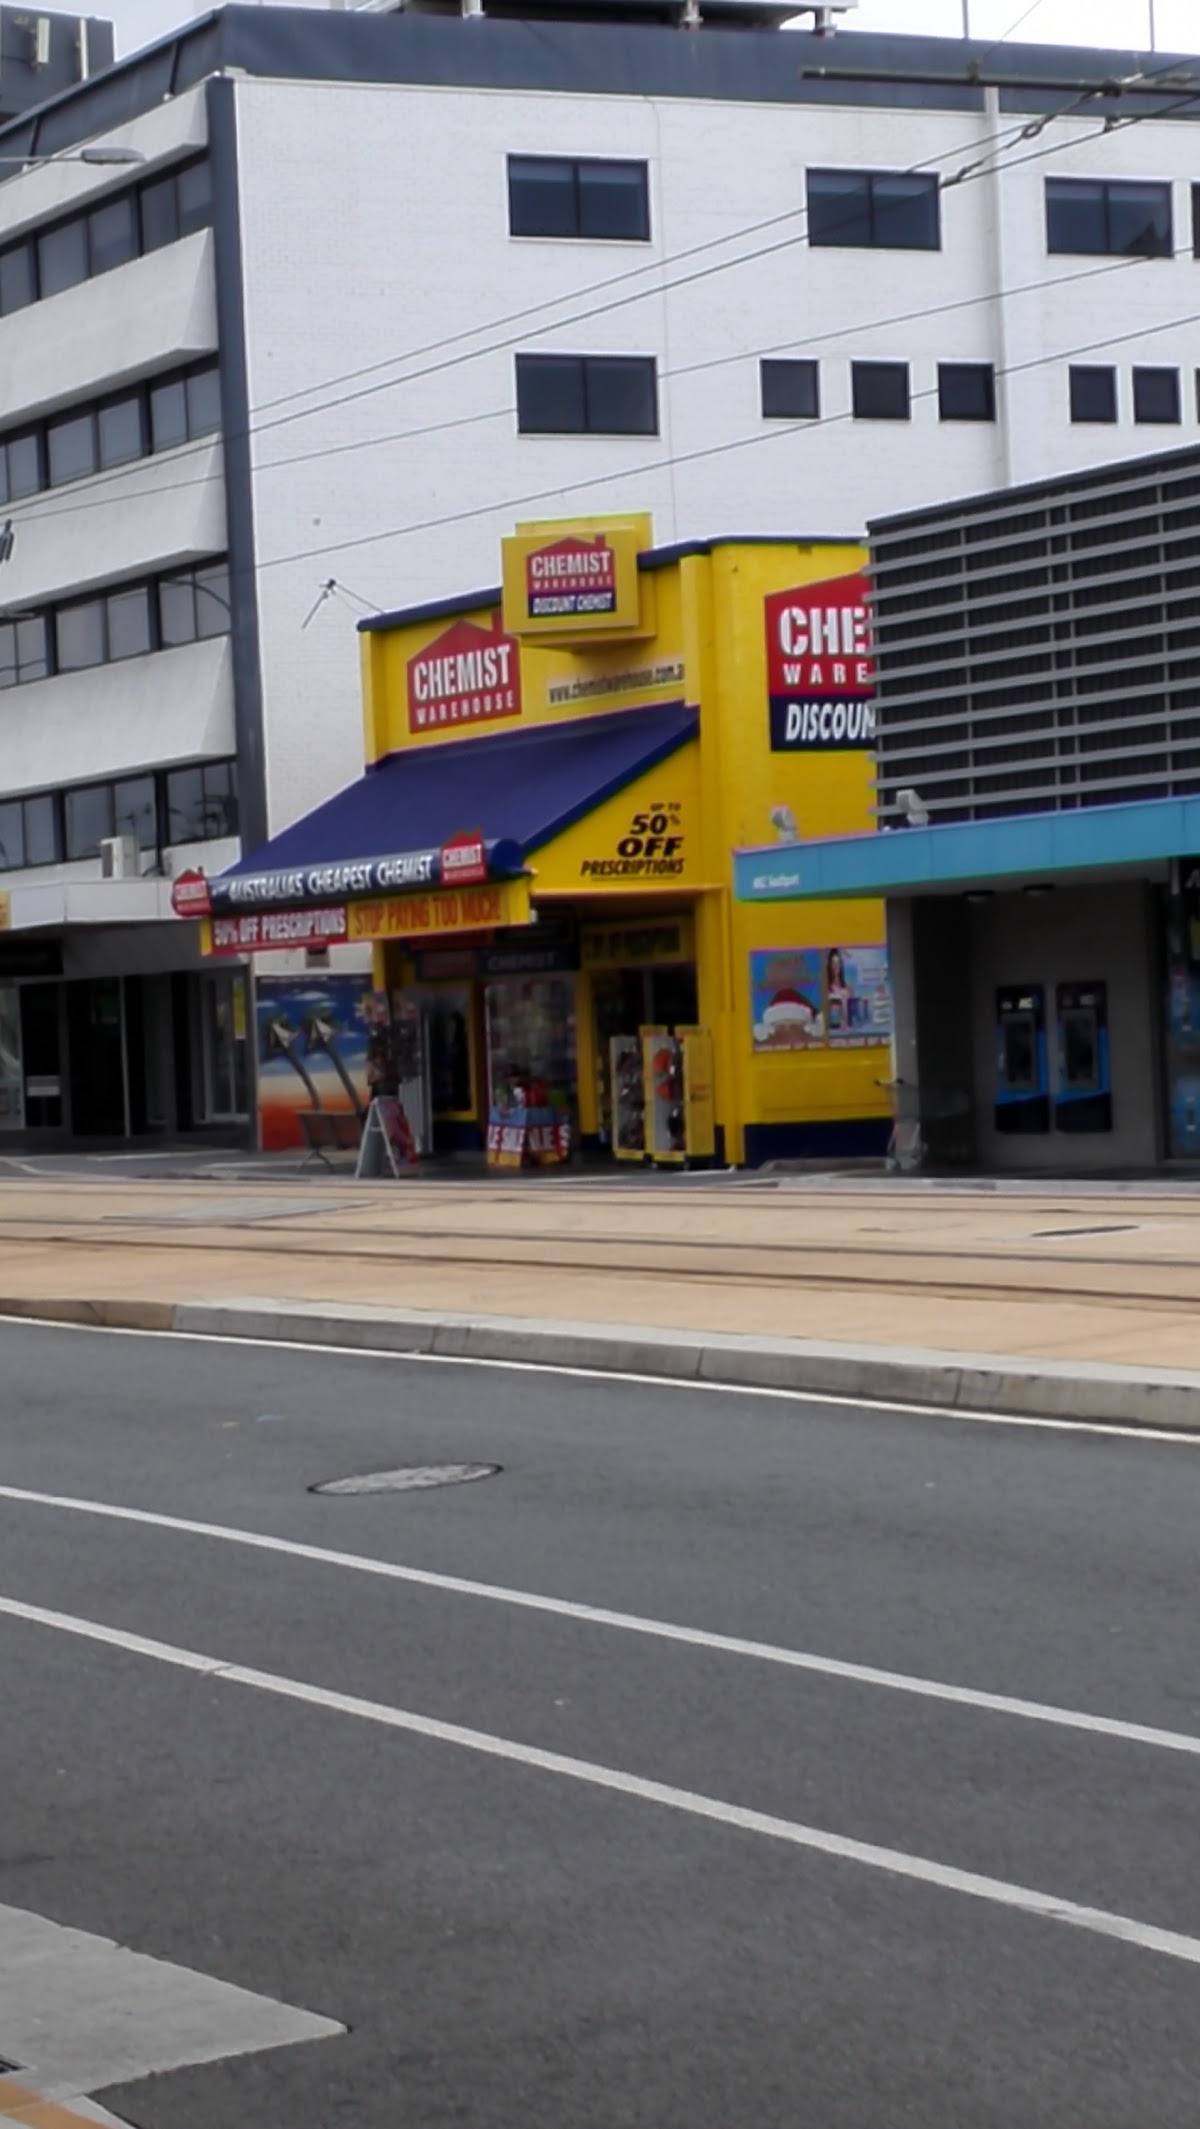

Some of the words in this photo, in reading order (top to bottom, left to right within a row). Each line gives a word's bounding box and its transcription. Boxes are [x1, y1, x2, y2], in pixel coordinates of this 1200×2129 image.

[531, 551, 611, 578] CHEMIST
[780, 606, 873, 656] CHE
[414, 644, 511, 702] CHEMIST
[417, 689, 514, 725] WAREHOUSE
[617, 836, 684, 858] OFF
[307, 863, 373, 895] CHEAPEST
[376, 855, 434, 886] CHEMIST
[580, 858, 685, 877] PRESCRIPTIONS
